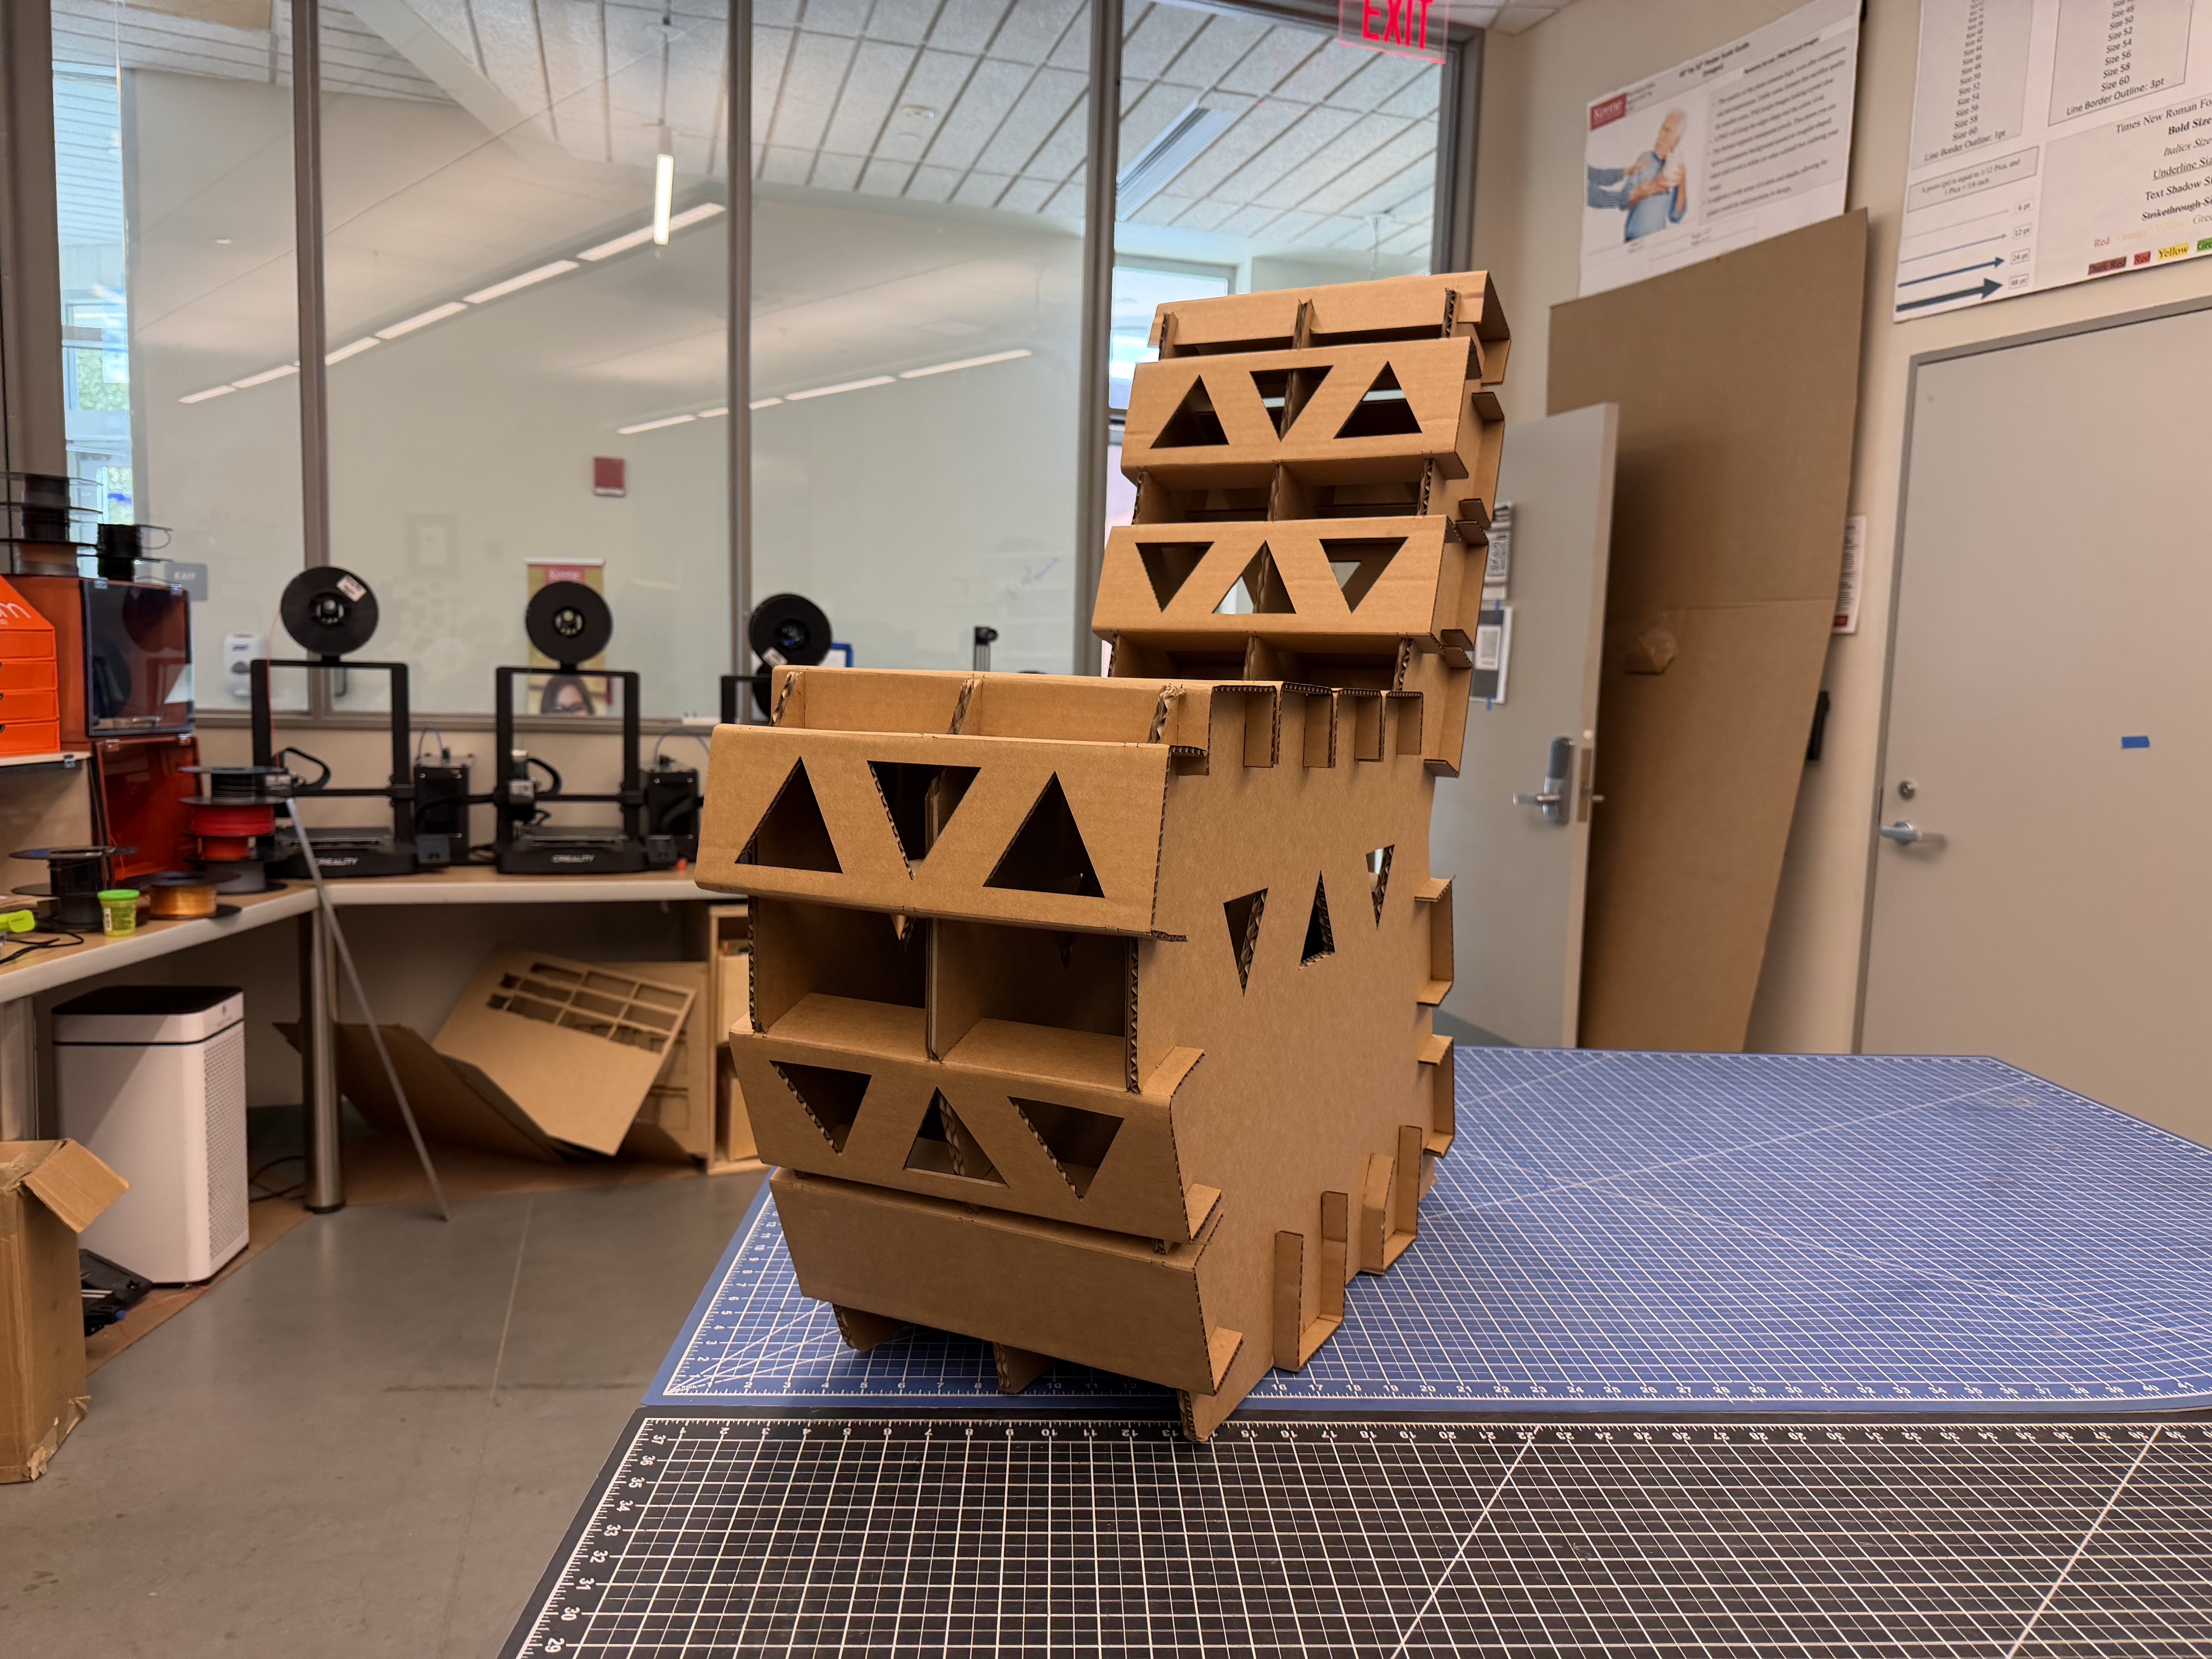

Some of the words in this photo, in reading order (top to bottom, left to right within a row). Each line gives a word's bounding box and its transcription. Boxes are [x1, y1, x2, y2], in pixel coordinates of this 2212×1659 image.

[1362, 0, 1434, 50] EXIT
[2110, 21, 2123, 29] Size
[2108, 32, 2122, 41] Size
[2107, 44, 2120, 53] Size
[2105, 55, 2119, 65] Size
[2103, 68, 2118, 78] Size
[2121, 62, 2130, 72] 58
[2101, 81, 2117, 91] Size
[2119, 76, 2130, 86] 60
[2067, 105, 2083, 115] Line
[2085, 96, 2111, 109] Border
[2114, 84, 2148, 100] Outline:
[2149, 78, 2164, 90] 3pt
[2116, 120, 2141, 133] Times
[2143, 113, 2164, 125] New
[2166, 104, 2197, 118] Roman
[2169, 122, 2190, 135] Bold
[2192, 117, 2212, 128] Size
[2164, 143, 2191, 156] Italics
[2153, 161, 2197, 180] Underline
[2145, 190, 2164, 201] Text
[2166, 180, 2202, 196] Shadow
[2142, 199, 2201, 221] Strikethrough
[2159, 246, 2187, 258] Yellow
[651, 1434, 666, 1445] 37
[1516, 1432, 1535, 1440] 22
[1556, 1432, 1575, 1440] 23
[1595, 1432, 1614, 1440] 24
[1633, 1432, 1652, 1440] 25
[1672, 1432, 1691, 1440] 26
[1788, 1432, 1807, 1440] 29
[1826, 1432, 1846, 1440] 30
[1865, 1432, 1884, 1440] 31
[640, 1455, 656, 1465] 36
[629, 1477, 645, 1488] 35
[617, 1500, 634, 1511] 34
[604, 1524, 621, 1536] 33
[590, 1550, 608, 1563] 32
[576, 1578, 595, 1590] 31
[561, 1607, 580, 1621] 30
[545, 1638, 565, 1653] 29
